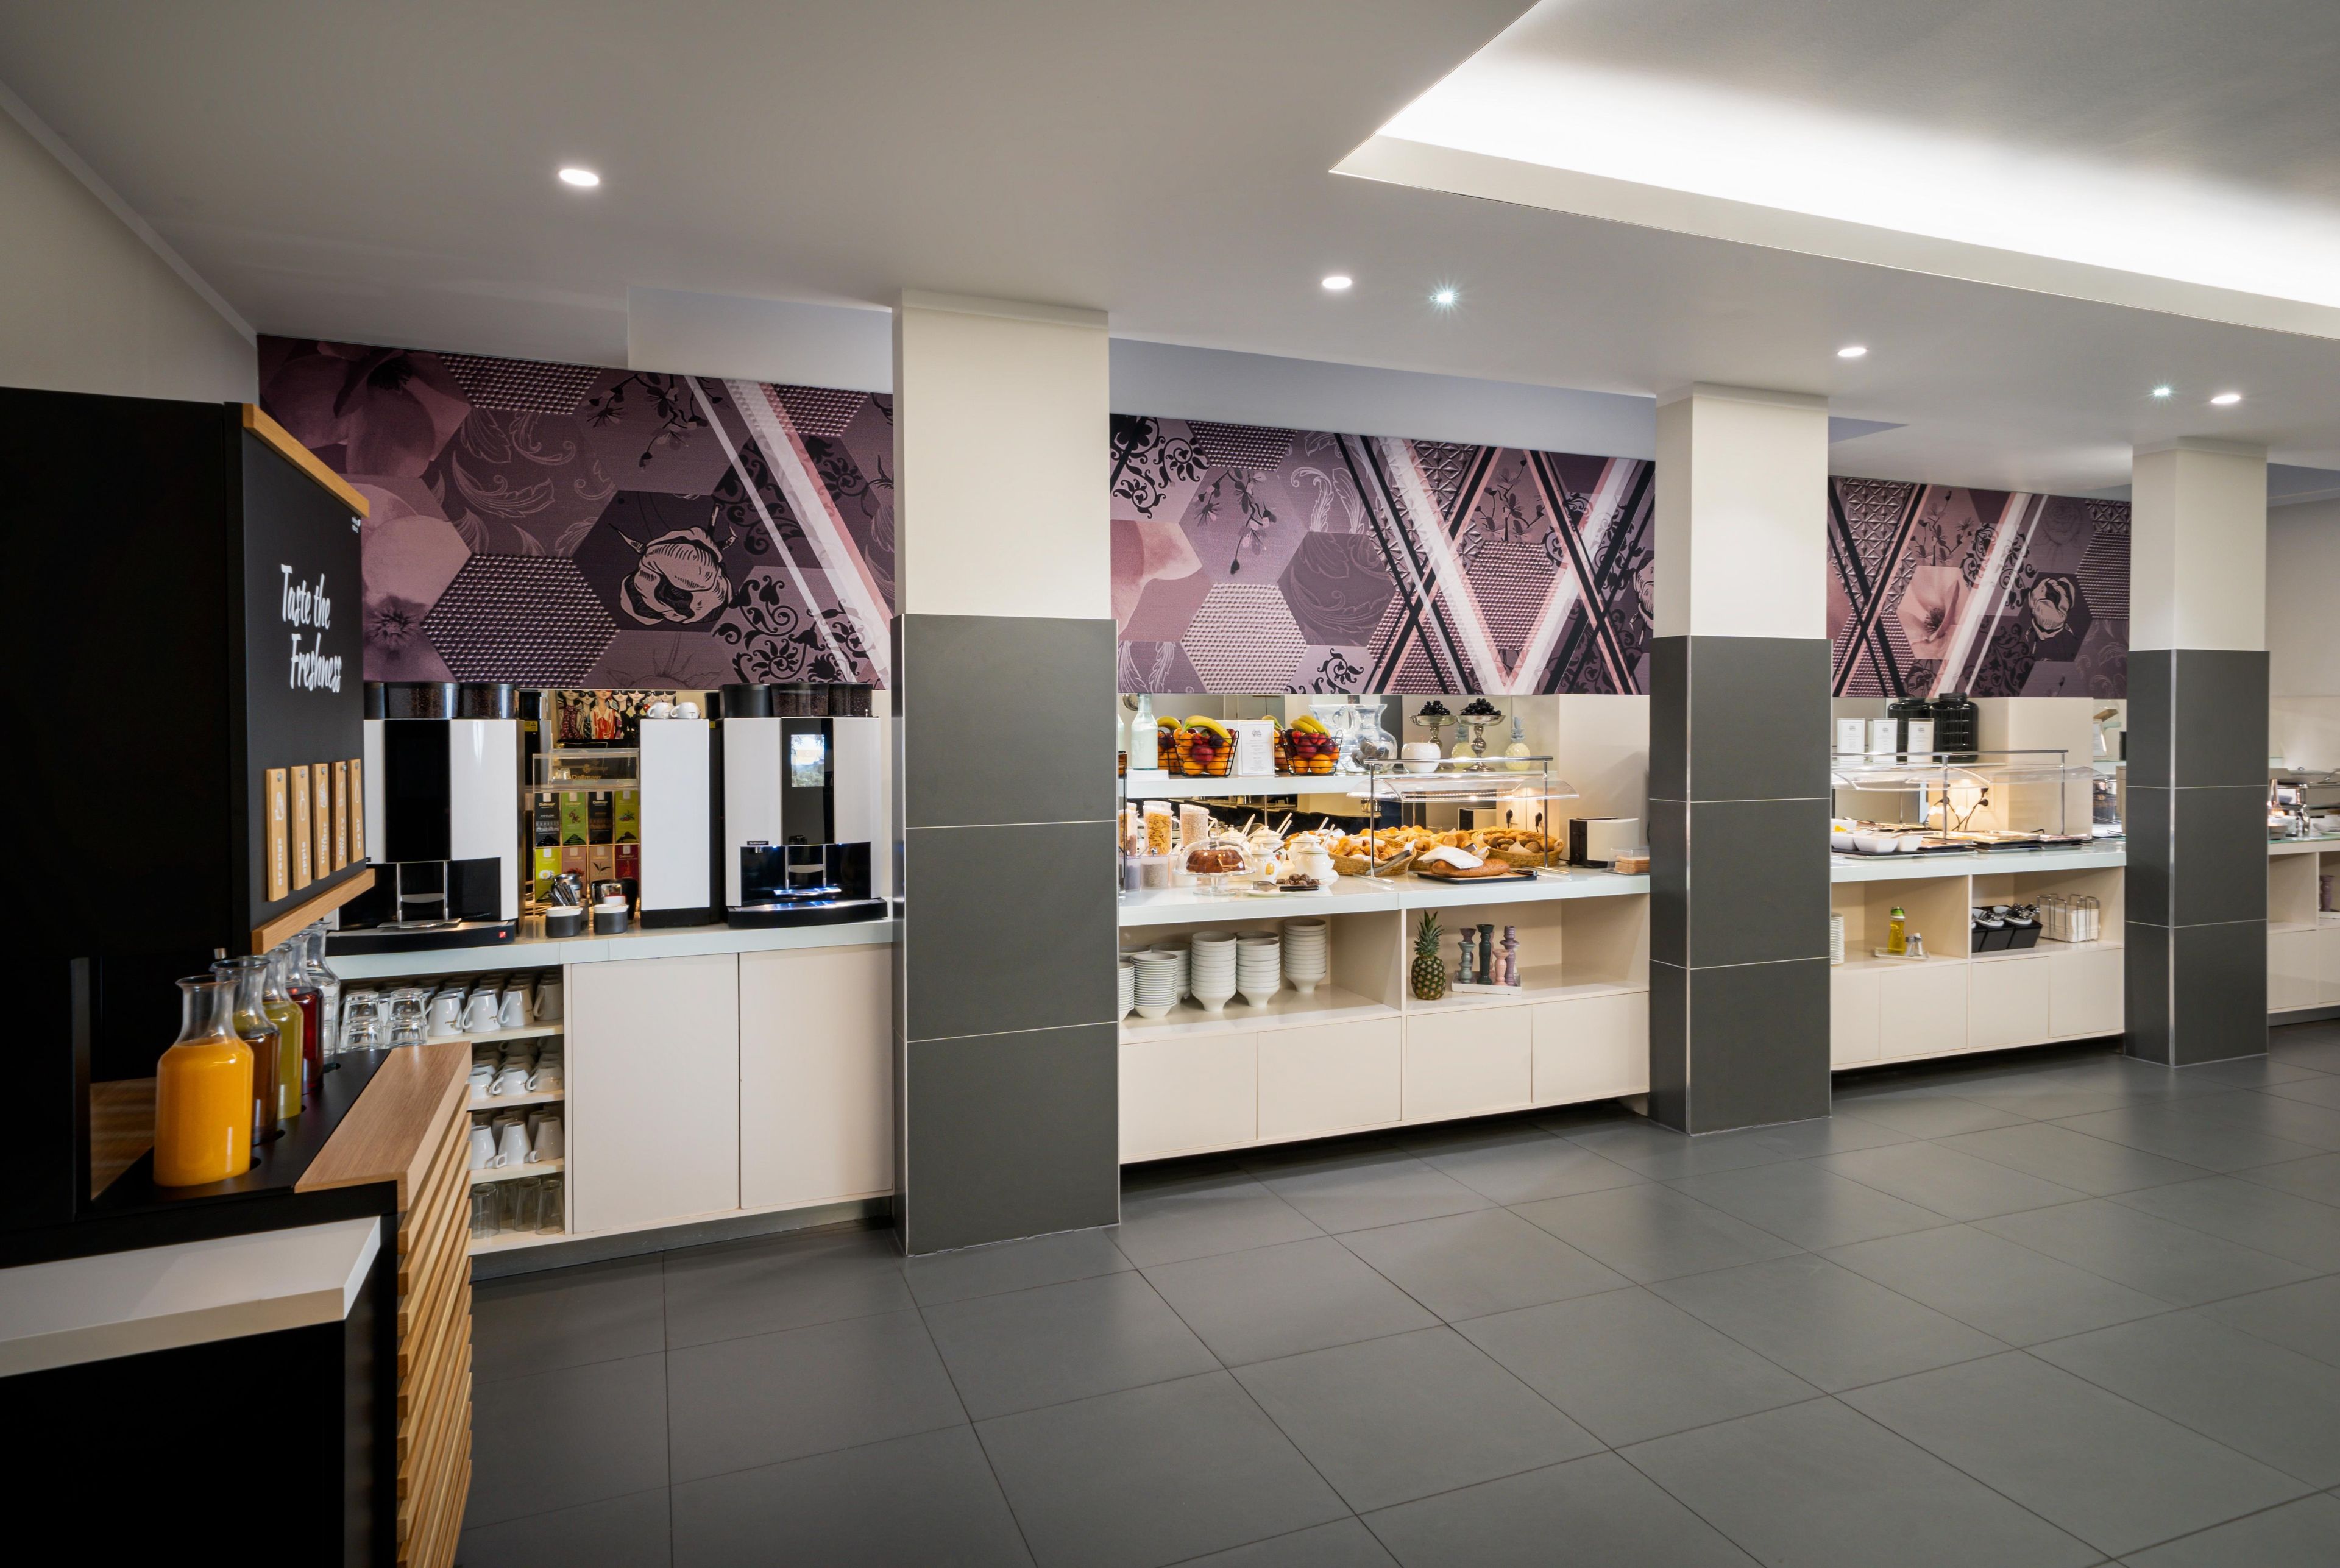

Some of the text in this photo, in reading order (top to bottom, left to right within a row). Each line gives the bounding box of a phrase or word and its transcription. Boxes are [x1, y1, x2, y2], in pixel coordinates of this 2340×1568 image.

[281, 564, 331, 630] Taste the
[290, 632, 342, 693] Freshness
